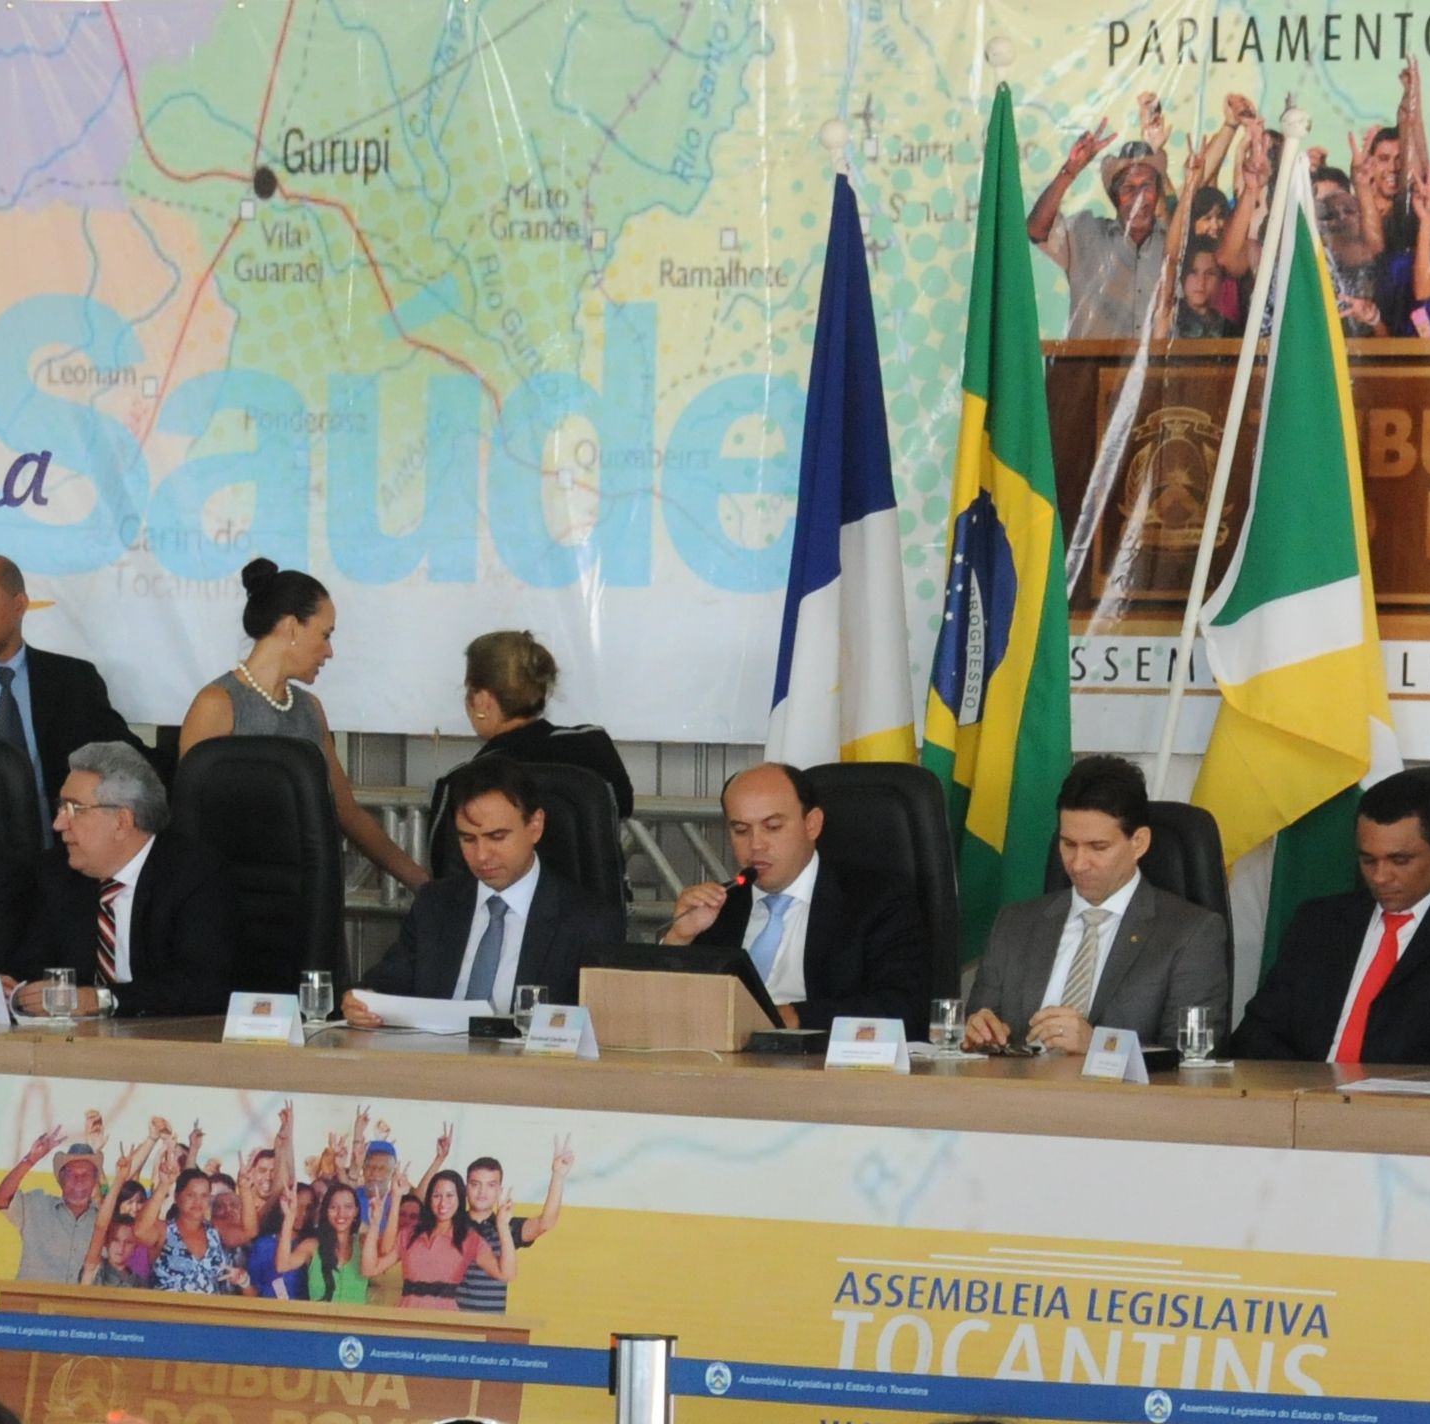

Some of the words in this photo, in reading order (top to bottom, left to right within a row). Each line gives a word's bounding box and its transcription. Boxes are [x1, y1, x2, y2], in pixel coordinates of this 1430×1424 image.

[282, 127, 390, 185] Gurupi
[261, 220, 303, 250] Vila
[833, 1270, 1071, 1321] ASSEMBLEIA
[1086, 1286, 1331, 1339] LEGISLATIVA
[59, 1328, 69, 1338] do
[69, 1328, 97, 1340] Estado
[97, 1330, 108, 1340] do
[109, 1331, 145, 1342] Tocantins
[458, 1353, 469, 1364] do
[469, 1354, 498, 1366] Estado
[499, 1356, 510, 1366] do
[511, 1357, 549, 1369] Tocantins
[831, 1309, 1329, 1397] TOCANTINS
[833, 1380, 844, 1390] do
[845, 1381, 875, 1393] Estado
[875, 1383, 888, 1394] do
[889, 1384, 929, 1396] Tocantins
[1277, 1408, 1289, 1419] do
[1291, 1409, 1321, 1420] Estado
[1323, 1411, 1335, 1422] do
[1337, 1412, 1379, 1424] Tocantins
